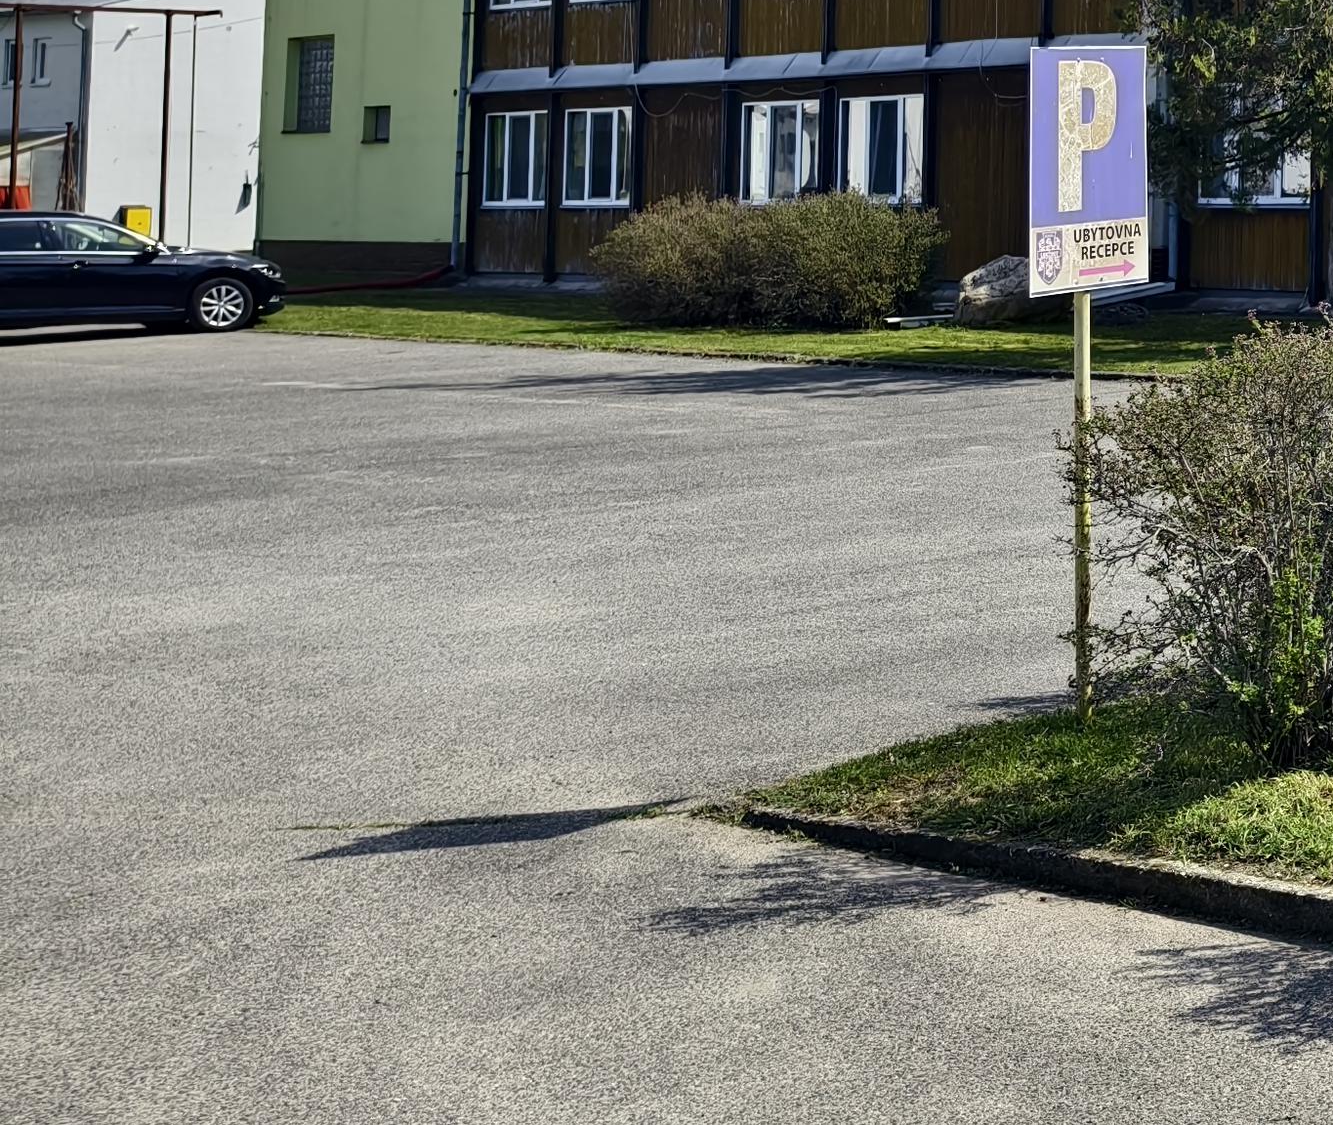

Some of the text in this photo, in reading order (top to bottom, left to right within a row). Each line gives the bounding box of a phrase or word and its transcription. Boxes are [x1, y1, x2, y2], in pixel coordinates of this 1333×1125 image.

[1058, 59, 1119, 213] P
[1073, 223, 1142, 243] UBYTOVNA
[1081, 241, 1135, 260] RECEPCE
